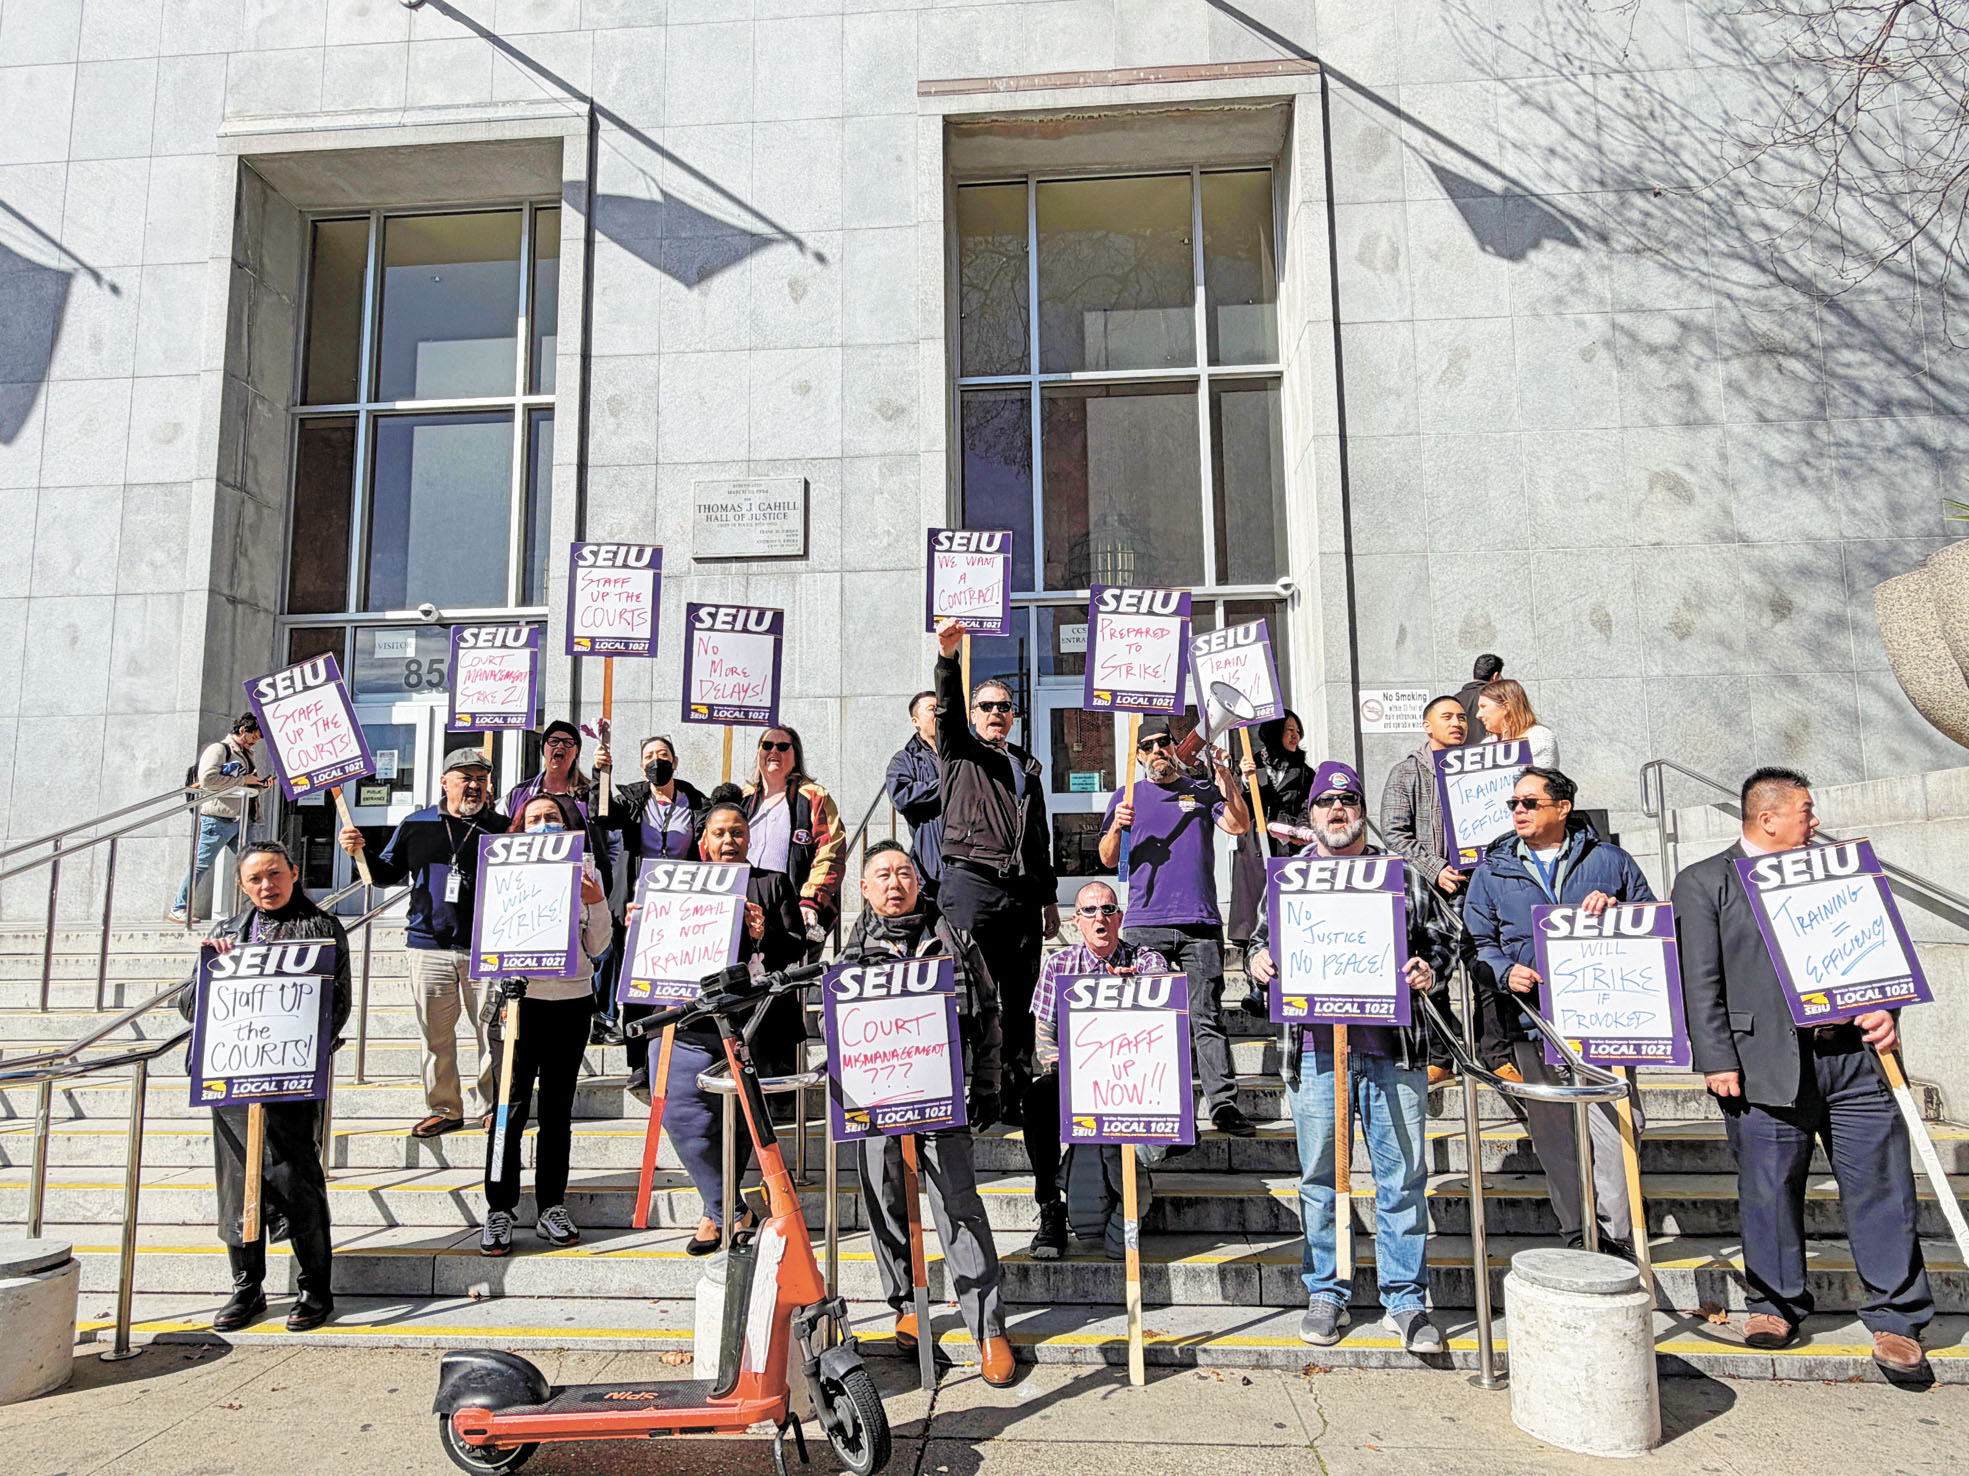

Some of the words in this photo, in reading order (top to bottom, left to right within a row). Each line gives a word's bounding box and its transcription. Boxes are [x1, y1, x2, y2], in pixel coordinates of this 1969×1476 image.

[696, 503, 743, 513] THOMAS
[757, 501, 799, 512] CAHILL
[705, 514, 731, 523] HALL
[733, 513, 746, 522] OF
[748, 512, 789, 521] JUSTICE
[935, 531, 1003, 552] SEIU
[578, 546, 654, 567] SEIU
[938, 555, 958, 568] WE
[966, 555, 999, 568] WANT
[581, 570, 632, 592] STAFF
[958, 572, 967, 584] A
[590, 591, 609, 601] UP
[614, 591, 642, 603] THE
[1099, 588, 1181, 614] SEIU
[580, 605, 648, 632] COURTS
[695, 607, 773, 631] SEIU
[983, 620, 1001, 628] 1021
[460, 627, 530, 648] SEIU
[1100, 618, 1171, 642] PREPARED
[1195, 624, 1257, 656] SEIU
[376, 641, 413, 650] VISITOR
[595, 641, 626, 650] LOCAL
[627, 642, 649, 651] 1021
[1125, 642, 1143, 655] TO
[460, 651, 515, 668] COURT
[709, 659, 750, 678] MORE
[1100, 653, 1171, 683] STRIKE!
[1201, 654, 1248, 674] TRAIN
[259, 658, 327, 704] SEIU
[699, 675, 768, 704] DELAYS!
[1116, 695, 1149, 704] LOCAL
[1152, 698, 1174, 706] 1021
[1383, 692, 1393, 702] No
[1395, 692, 1427, 703] Smoking
[272, 700, 324, 733] STAFF
[475, 716, 504, 724] LOCAL
[507, 716, 526, 724] 1021
[713, 709, 746, 718] LOCAL
[748, 711, 770, 720] 1021
[286, 728, 304, 745] UP
[311, 713, 342, 738] THE
[287, 726, 353, 771] COURTS!
[1445, 741, 1520, 774] SEIU
[313, 769, 343, 785] LOCAL
[344, 760, 364, 773] 1021
[1458, 806, 1511, 841] EFFICIE
[488, 834, 573, 864] SEIU
[1280, 859, 1388, 891] SEIU
[1756, 843, 1860, 890] SEIU
[495, 870, 525, 895] WE
[648, 864, 739, 892] SEIU
[502, 884, 542, 913] WILL
[492, 886, 567, 947] STRIKE!
[644, 901, 672, 923] AN
[679, 897, 731, 921] EMAIL
[1772, 884, 1864, 938] TRAINING
[650, 929, 665, 943] IS
[680, 921, 718, 937] NOT
[1302, 920, 1367, 945] JUSTICE
[1547, 905, 1657, 938] SEIU
[634, 938, 728, 977] TRAINING
[1581, 941, 1628, 959] WILL
[1806, 915, 1885, 984] EFFICIENCY
[212, 944, 321, 979] SEIU
[503, 957, 538, 967] LOCAL
[541, 957, 566, 967] 1021
[1323, 943, 1391, 980] PEACE!
[836, 959, 940, 1000] SEIU
[1553, 958, 1660, 997] STRIKE
[213, 984, 274, 1021] Staff
[279, 982, 313, 1013] UP
[655, 986, 693, 997] LOCAL
[1070, 976, 1172, 1009] SEIU
[1597, 992, 1611, 1005] IF
[1837, 989, 1882, 1005] LOCAL
[1885, 983, 1915, 997] 1021
[1282, 1007, 1308, 1016] SEIU
[1314, 1002, 1360, 1013] LOCAL
[1364, 1003, 1395, 1014] 1021
[1804, 1004, 1831, 1016] SEIU
[842, 1007, 936, 1047] COURT
[1561, 1009, 1657, 1030] PROVOKED
[232, 1021, 271, 1042] the
[211, 1035, 313, 1073] COURTS!
[1074, 1017, 1165, 1070] STAFF
[1589, 1044, 1637, 1055] LOCAL
[1641, 1045, 1672, 1055] 1021
[842, 1042, 951, 1072] MISMANAGEMENT
[1112, 1059, 1136, 1081] UP
[201, 1090, 226, 1101] SEIU
[232, 1083, 277, 1094] LOCAL
[282, 1079, 314, 1090] 1021
[1092, 1061, 1167, 1110] NOW!!
[877, 1111, 920, 1125] LOCAL
[925, 1105, 952, 1118] 1021
[844, 1122, 870, 1133] SEIU
[1072, 1128, 1097, 1137] SEIU
[1102, 1122, 1147, 1132] LOCAL
[1150, 1122, 1180, 1133] 1021
[603, 1391, 660, 1401] SPIN
